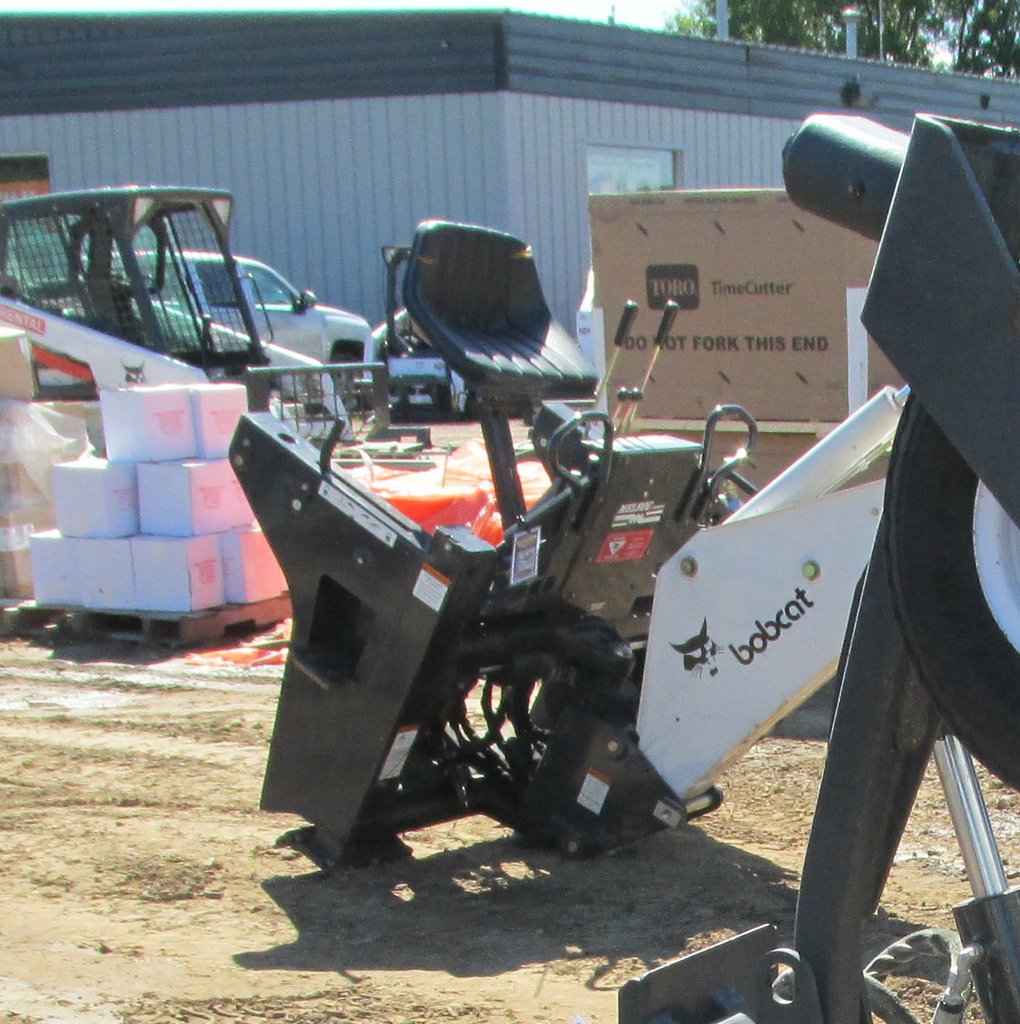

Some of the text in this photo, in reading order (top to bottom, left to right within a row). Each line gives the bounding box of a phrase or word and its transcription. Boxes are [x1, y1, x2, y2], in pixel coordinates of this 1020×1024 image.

[710, 281, 794, 296] TimeCutter
[653, 336, 687, 350] OT
[693, 336, 738, 351] FORK
[744, 336, 785, 351] THIS
[792, 336, 829, 351] END
[728, 587, 814, 665] bobcat
